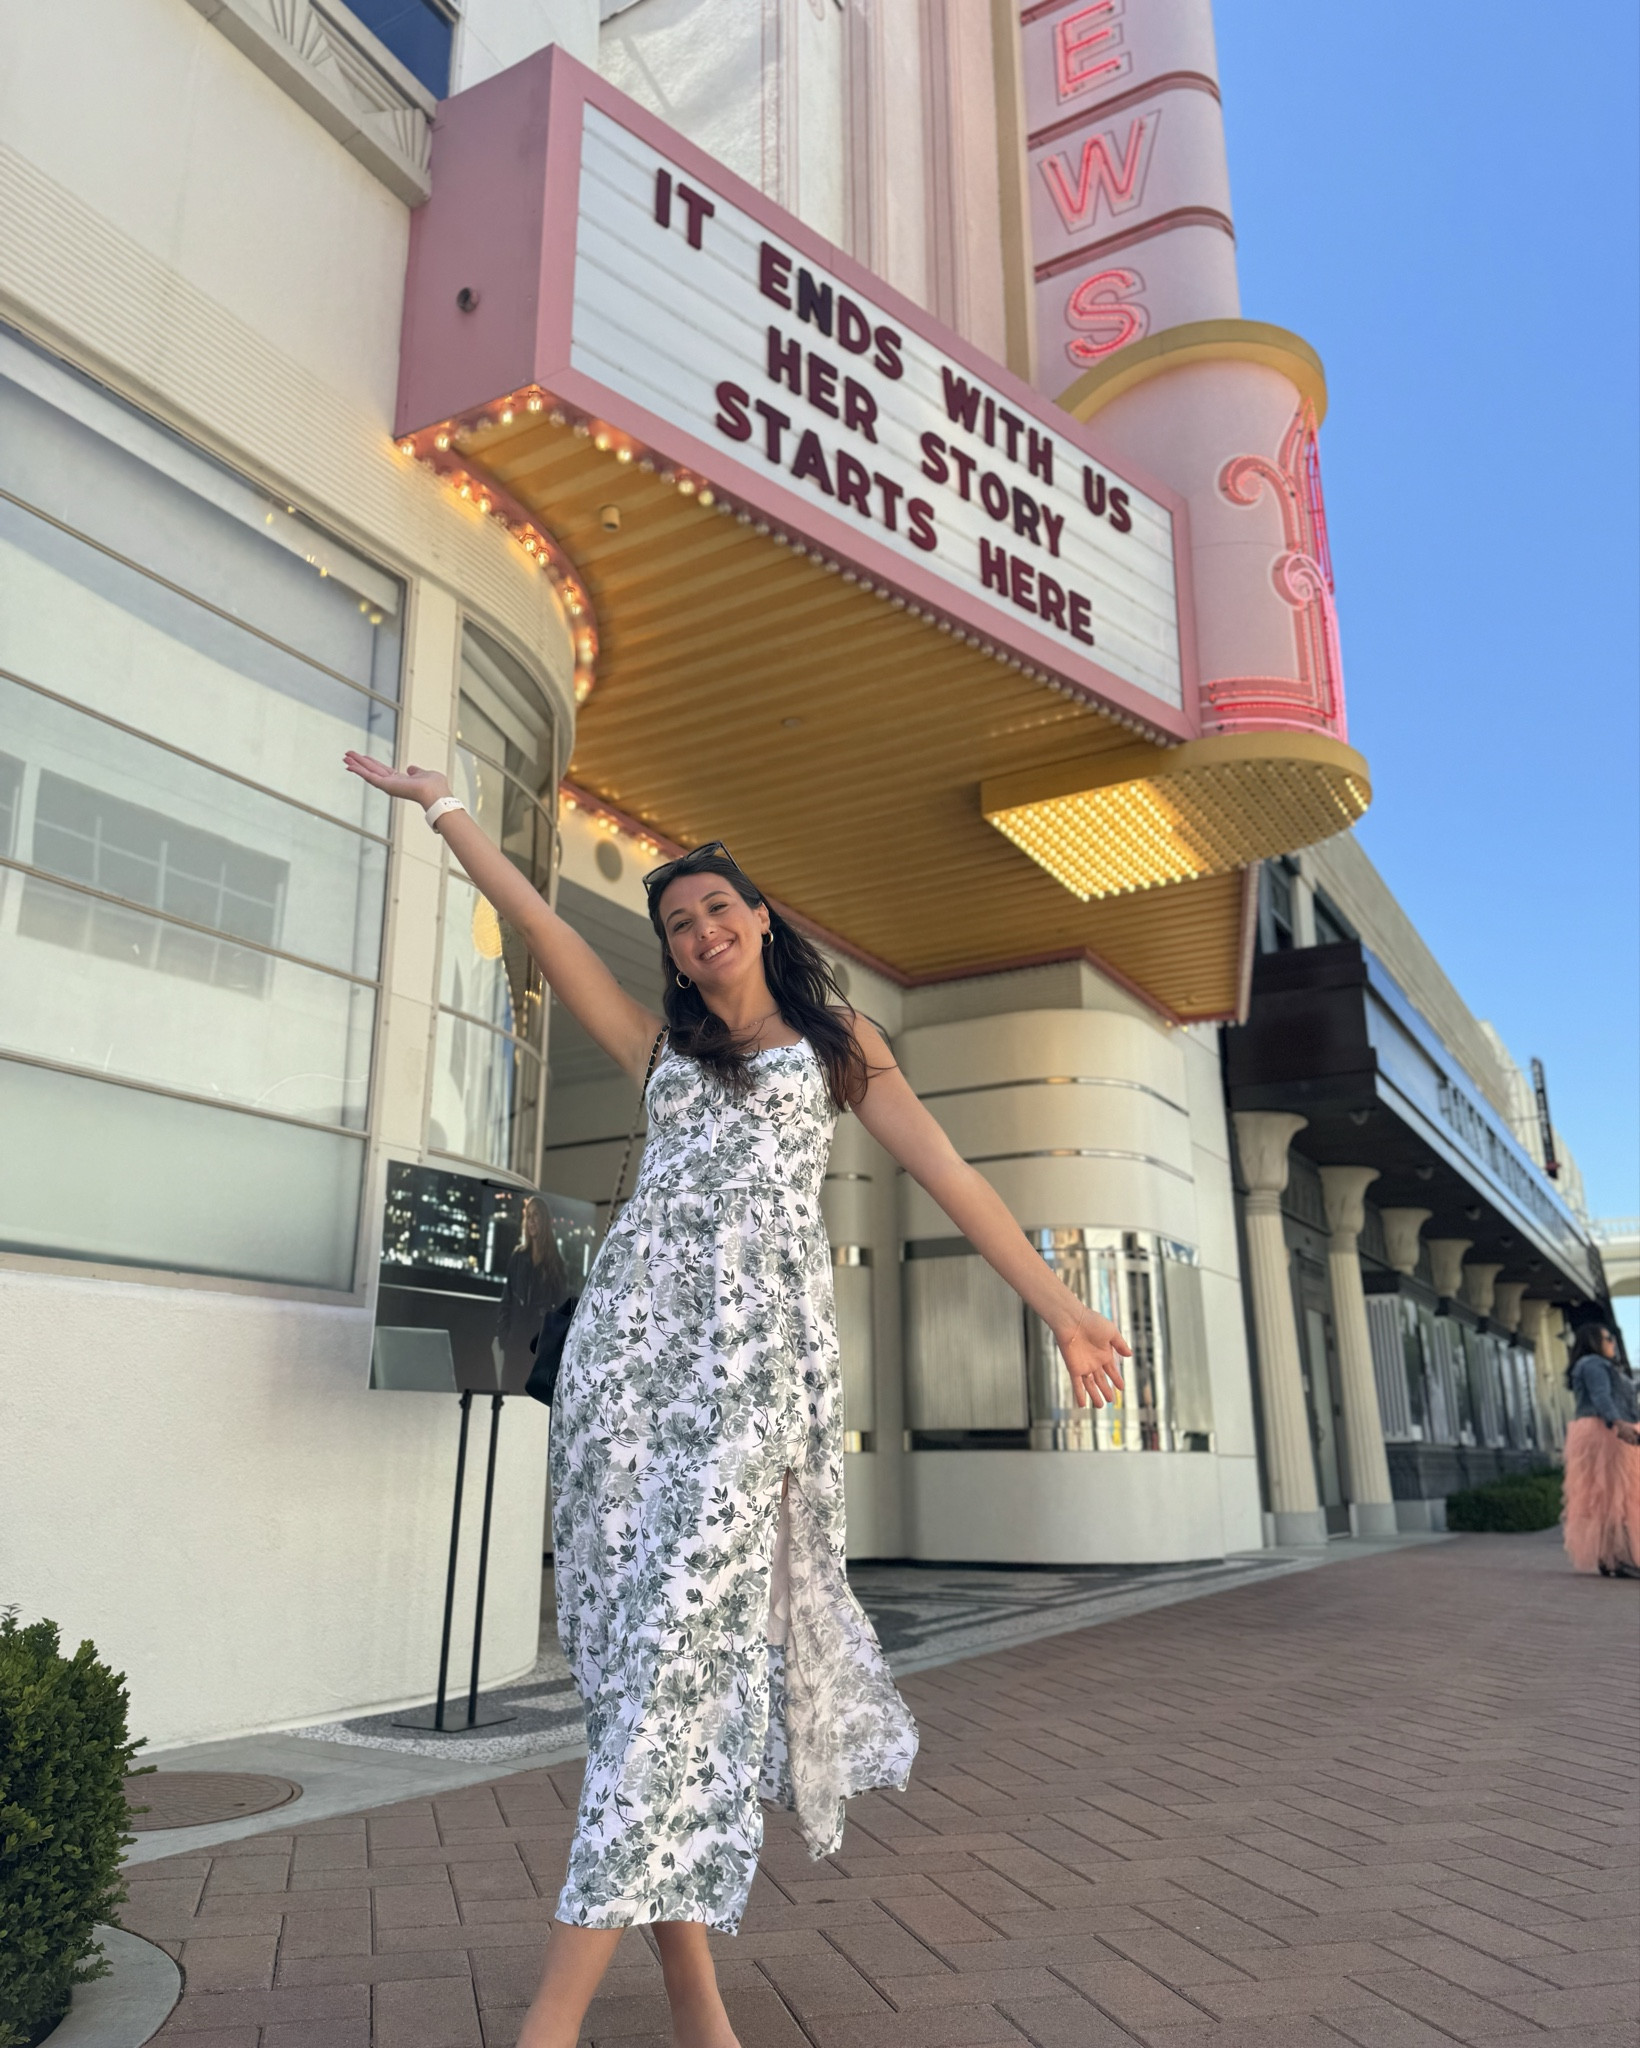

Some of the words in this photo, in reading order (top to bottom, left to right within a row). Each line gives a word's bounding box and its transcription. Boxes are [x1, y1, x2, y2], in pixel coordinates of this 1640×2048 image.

[653, 167, 715, 251] IT
[758, 240, 904, 381] ENDS
[941, 365, 1054, 487] WITH
[1082, 465, 1132, 534] US
[766, 325, 879, 445] HER
[920, 431, 1065, 558] STORY
[714, 380, 938, 552] STARTS
[979, 537, 1095, 646] HERE
